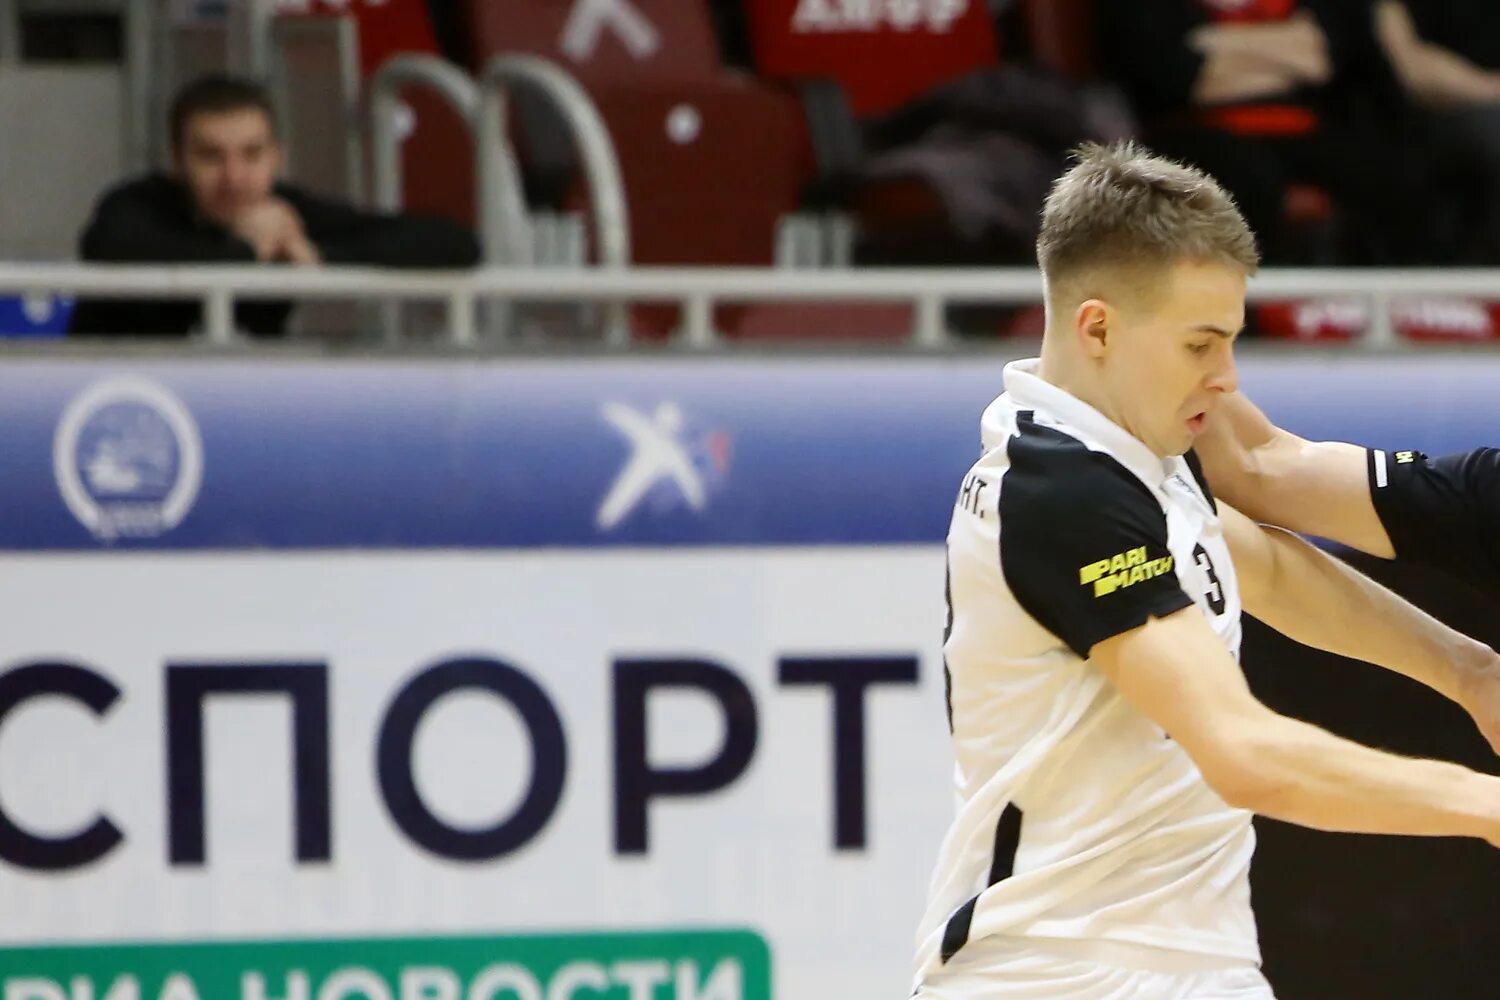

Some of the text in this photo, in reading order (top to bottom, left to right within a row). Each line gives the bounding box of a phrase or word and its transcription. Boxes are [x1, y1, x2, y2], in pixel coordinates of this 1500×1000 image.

[1079, 545, 1147, 585] PARI
[1094, 556, 1175, 598] MATCH
[0, 655, 921, 873] СПОРТ
